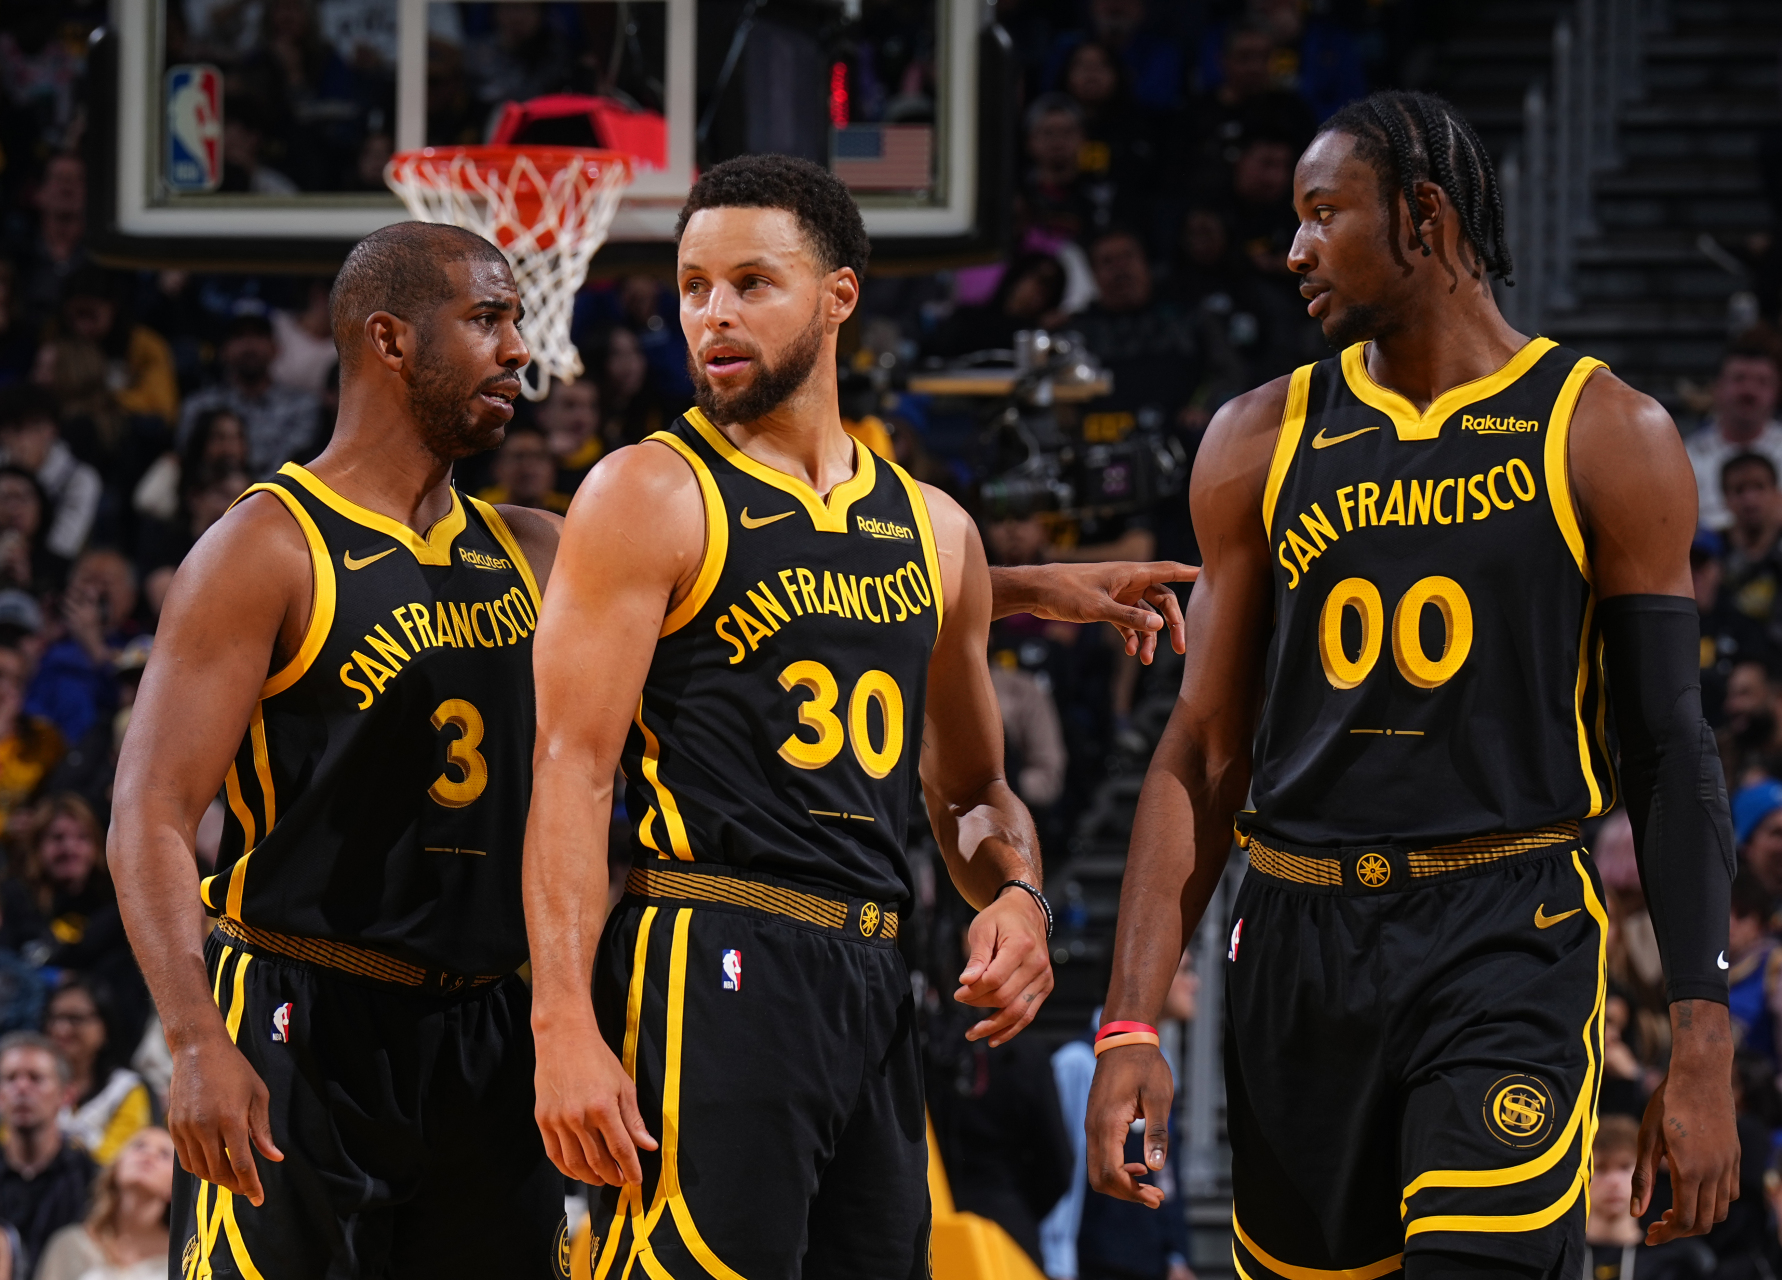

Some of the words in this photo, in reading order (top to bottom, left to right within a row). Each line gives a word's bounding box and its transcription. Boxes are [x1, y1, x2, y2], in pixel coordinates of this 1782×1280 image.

[1461, 414, 1539, 433] Rakuten
[458, 547, 513, 570] Rakuten
[856, 515, 915, 540] Rakuten
[1278, 502, 1340, 590] SAN
[1335, 457, 1537, 533] FRANCISCO
[339, 623, 412, 711] SAN
[391, 586, 537, 653] FRANCISCO
[715, 580, 792, 665] SAN
[777, 560, 932, 624] FRANCISCO
[1318, 575, 1474, 690] 00
[427, 698, 489, 809] 3
[777, 659, 905, 780] 30
